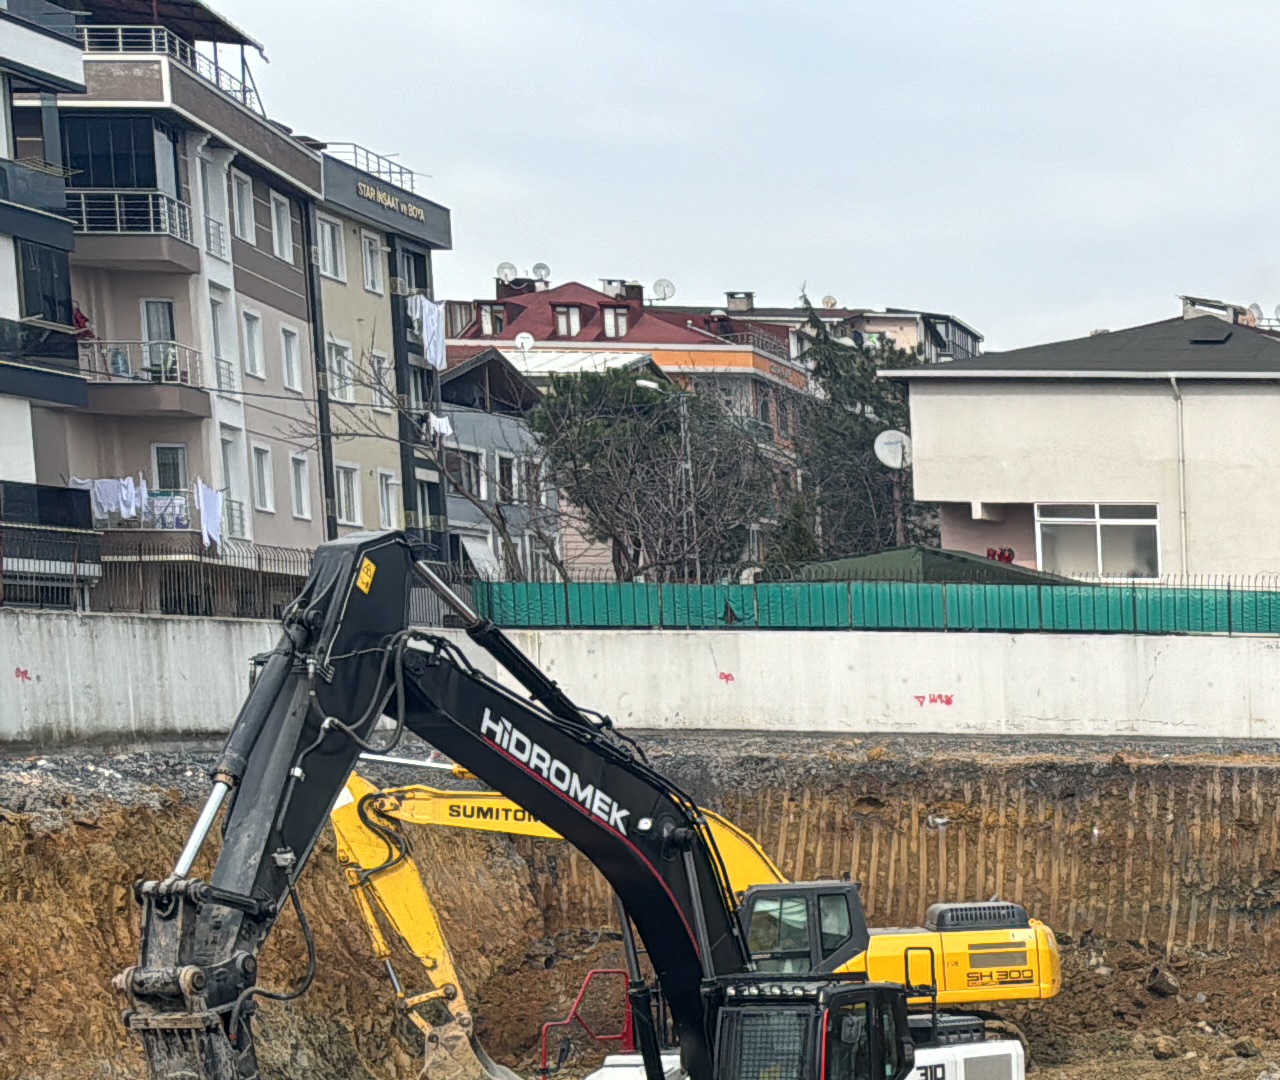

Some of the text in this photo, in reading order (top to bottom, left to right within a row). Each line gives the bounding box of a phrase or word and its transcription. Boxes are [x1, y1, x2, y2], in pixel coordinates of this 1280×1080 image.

[357, 182, 376, 202] STAR
[448, 804, 539, 823] SUMITO
[966, 969, 1034, 982] SH 300
